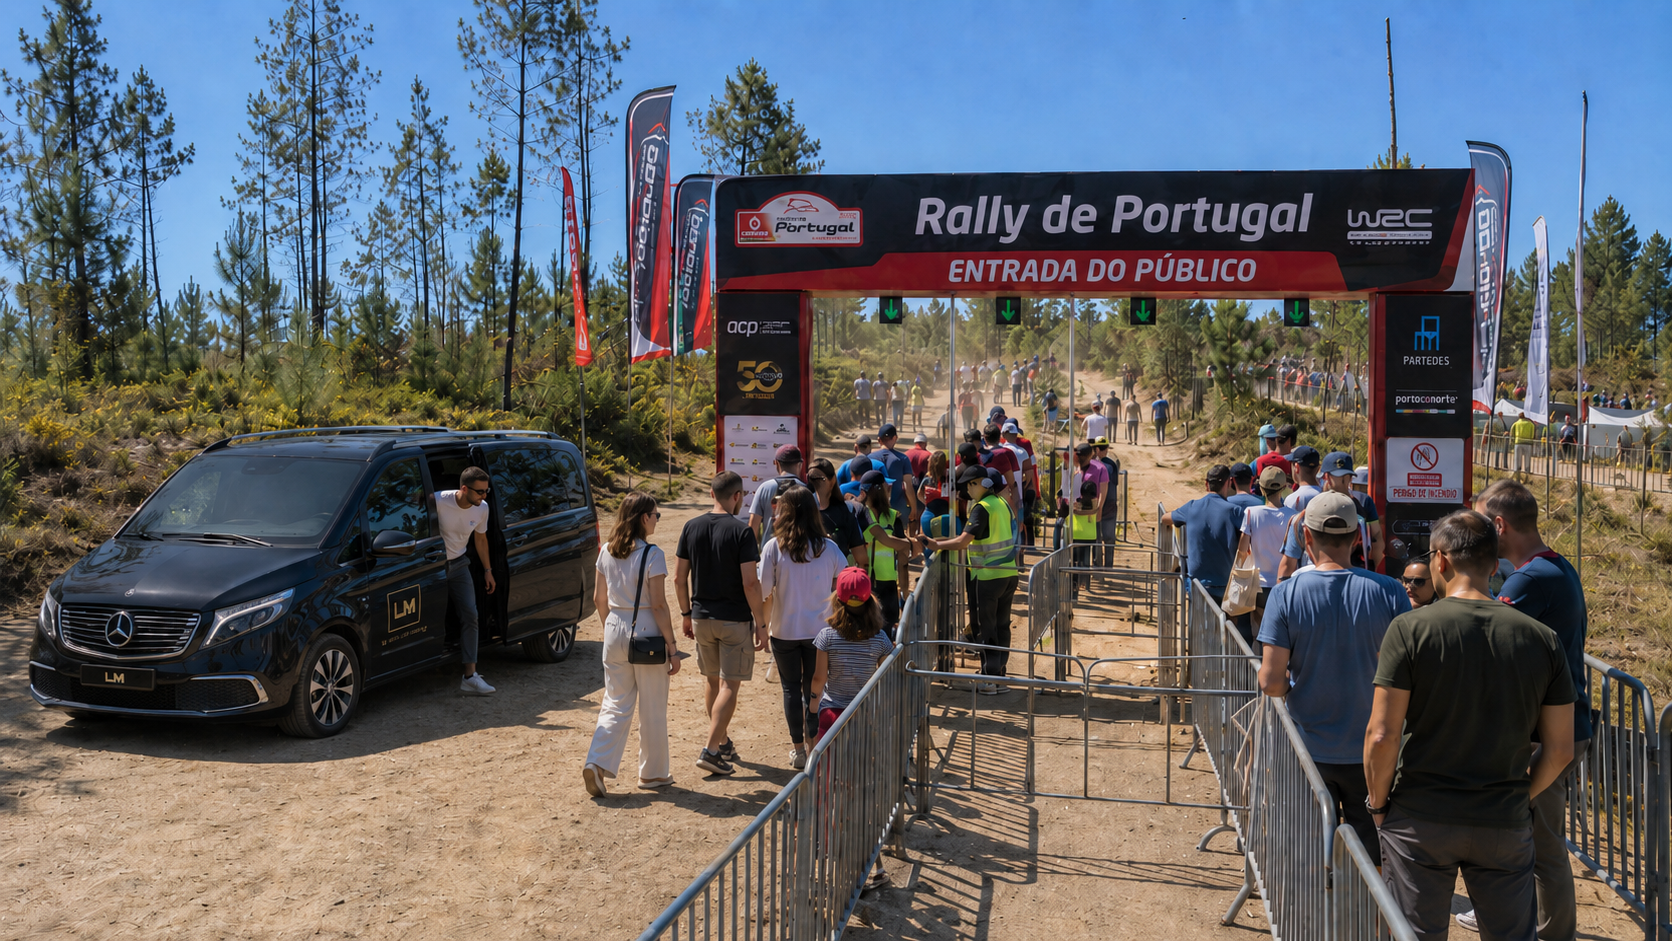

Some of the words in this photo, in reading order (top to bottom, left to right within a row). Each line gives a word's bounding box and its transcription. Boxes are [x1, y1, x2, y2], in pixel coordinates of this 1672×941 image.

[915, 195, 1031, 243] Rally
[1041, 195, 1097, 233] de
[1111, 193, 1314, 242] Portugal
[1347, 208, 1433, 228] WRC
[775, 222, 855, 236] Portugal
[948, 258, 1078, 282] ENTRADA
[1086, 258, 1126, 282] DO
[1134, 253, 1257, 282] PÚBLICO
[727, 320, 758, 337] acp
[1403, 355, 1450, 366] PARTEDES
[736, 360, 783, 393] 50
[394, 597, 416, 619] LM
[104, 671, 125, 684] LM
